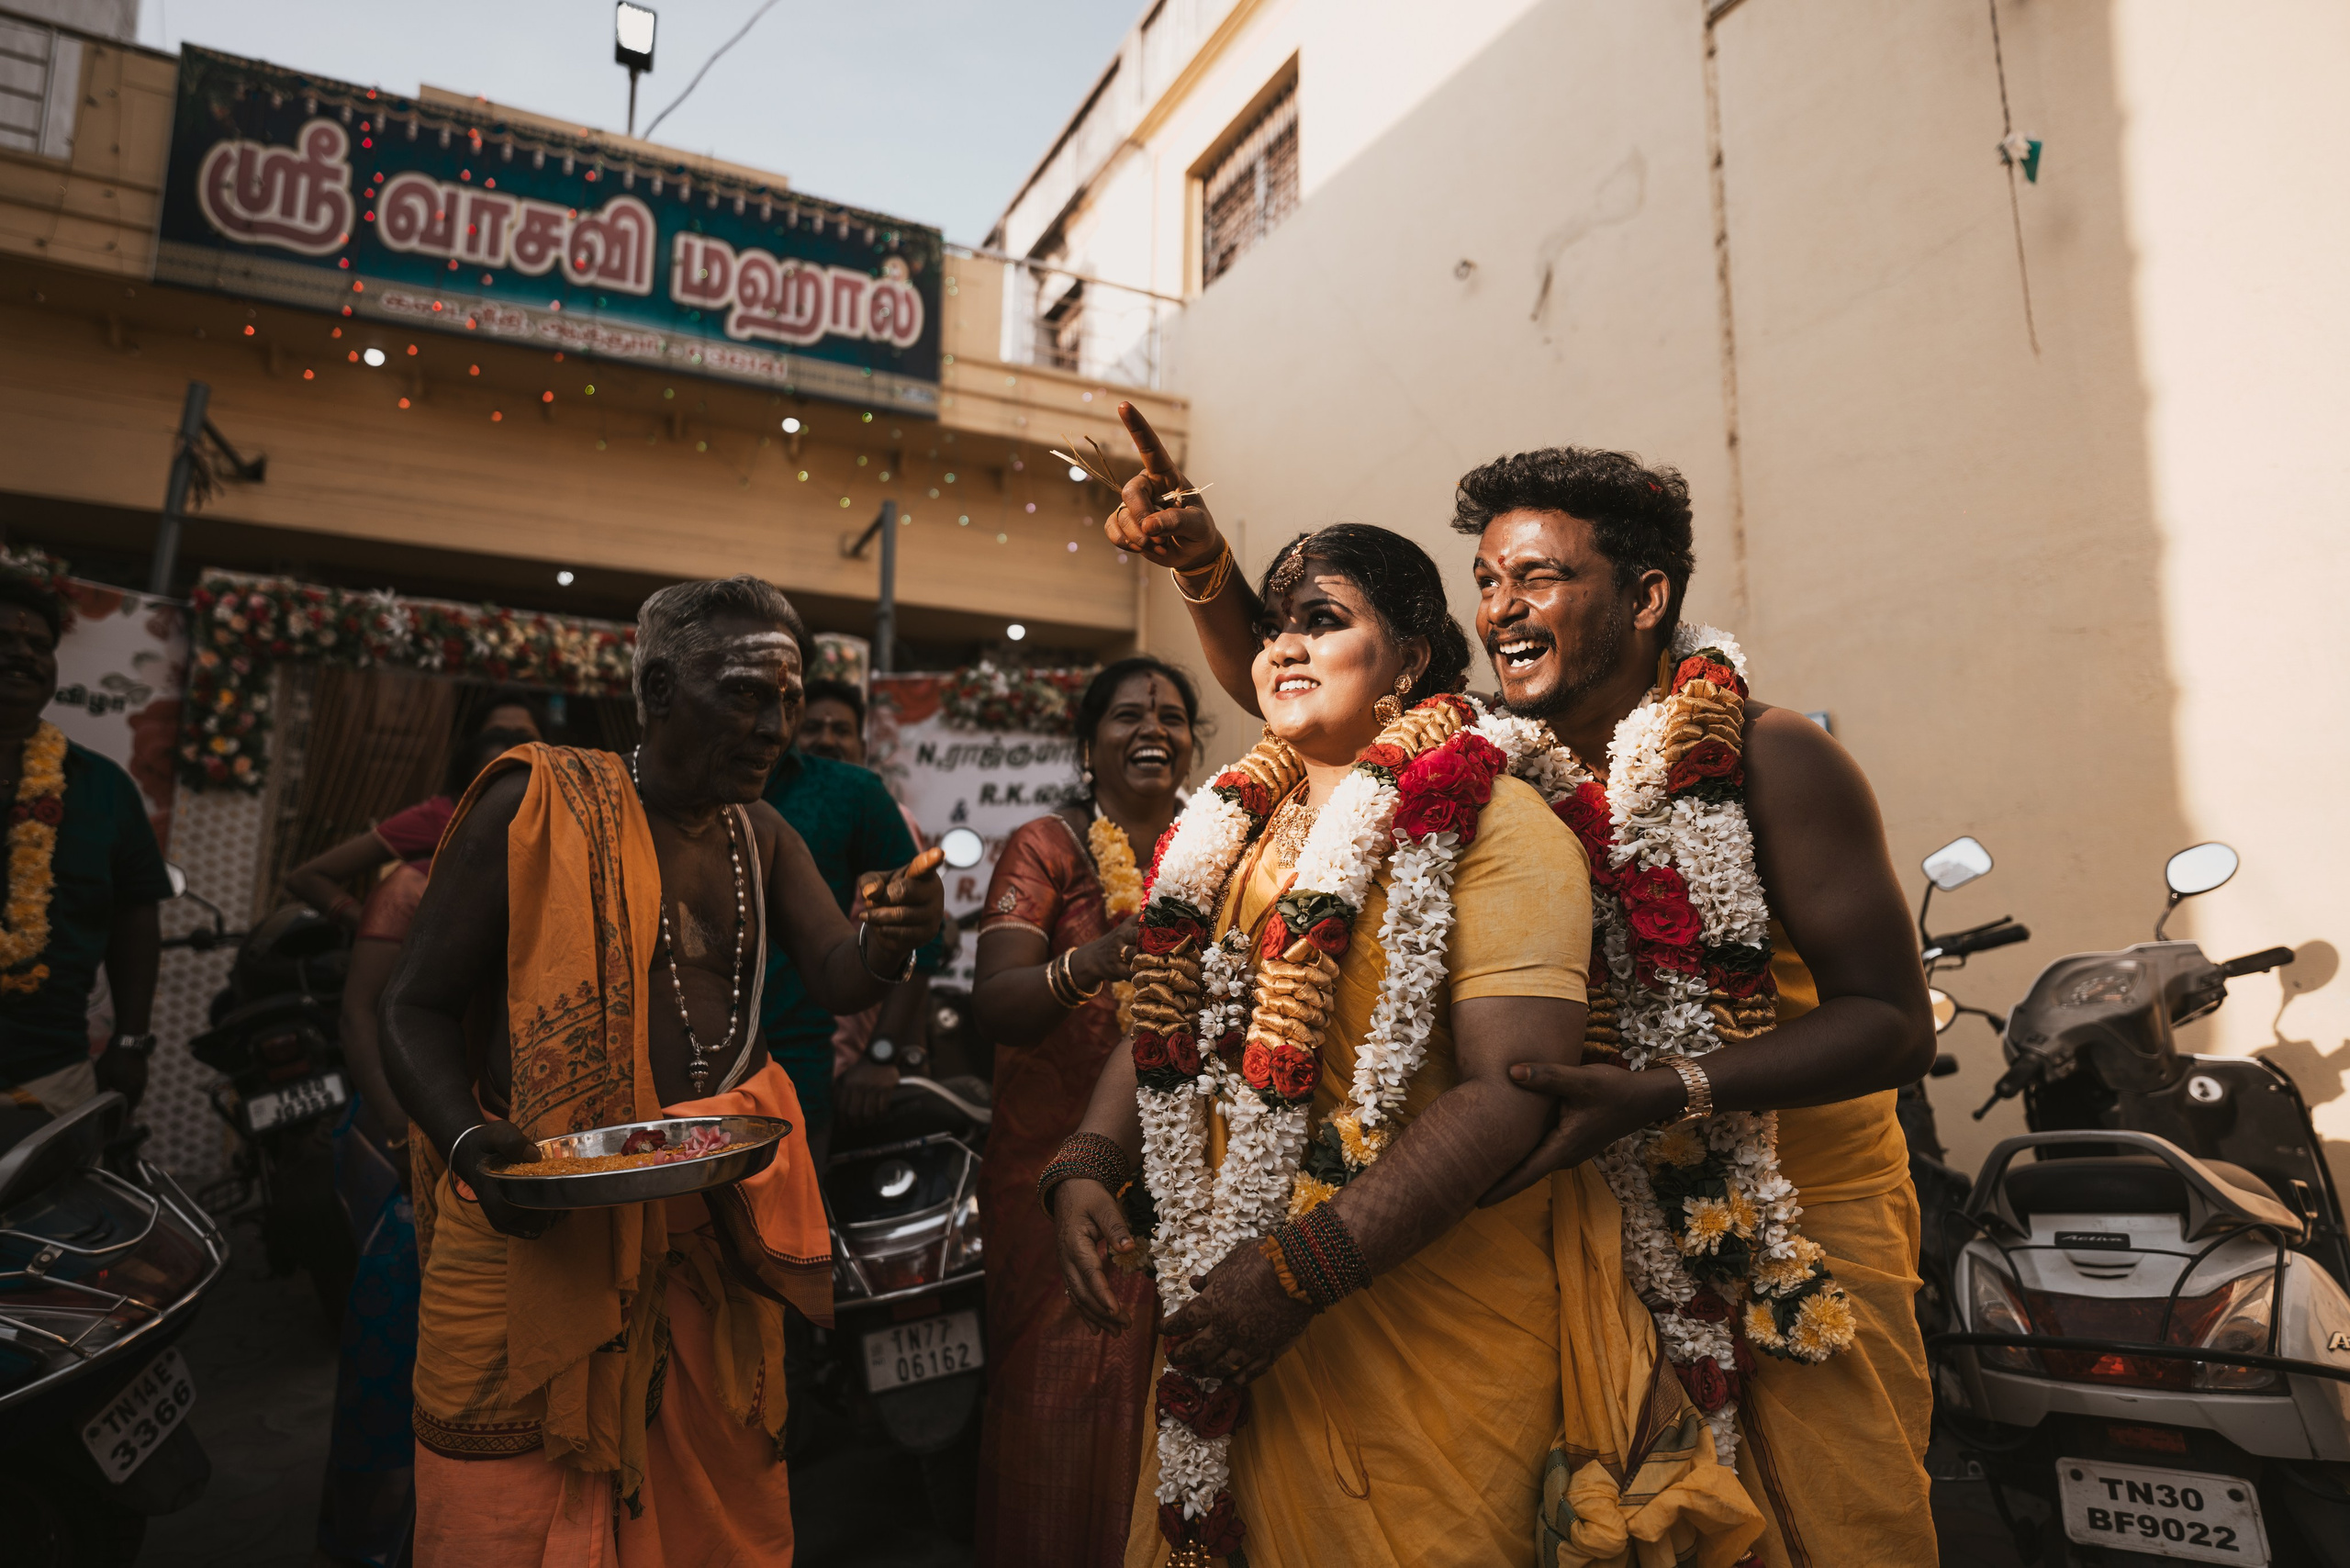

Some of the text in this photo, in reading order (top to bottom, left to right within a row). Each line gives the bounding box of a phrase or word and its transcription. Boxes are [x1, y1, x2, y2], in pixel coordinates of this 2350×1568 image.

[197, 118, 923, 350] ஸ்ரீ வாசவி மஹால்
[890, 1318, 950, 1354] TN77
[110, 1379, 191, 1471] 3366
[2098, 1477, 2204, 1512] TN30
[2087, 1507, 2240, 1552] BF9022
